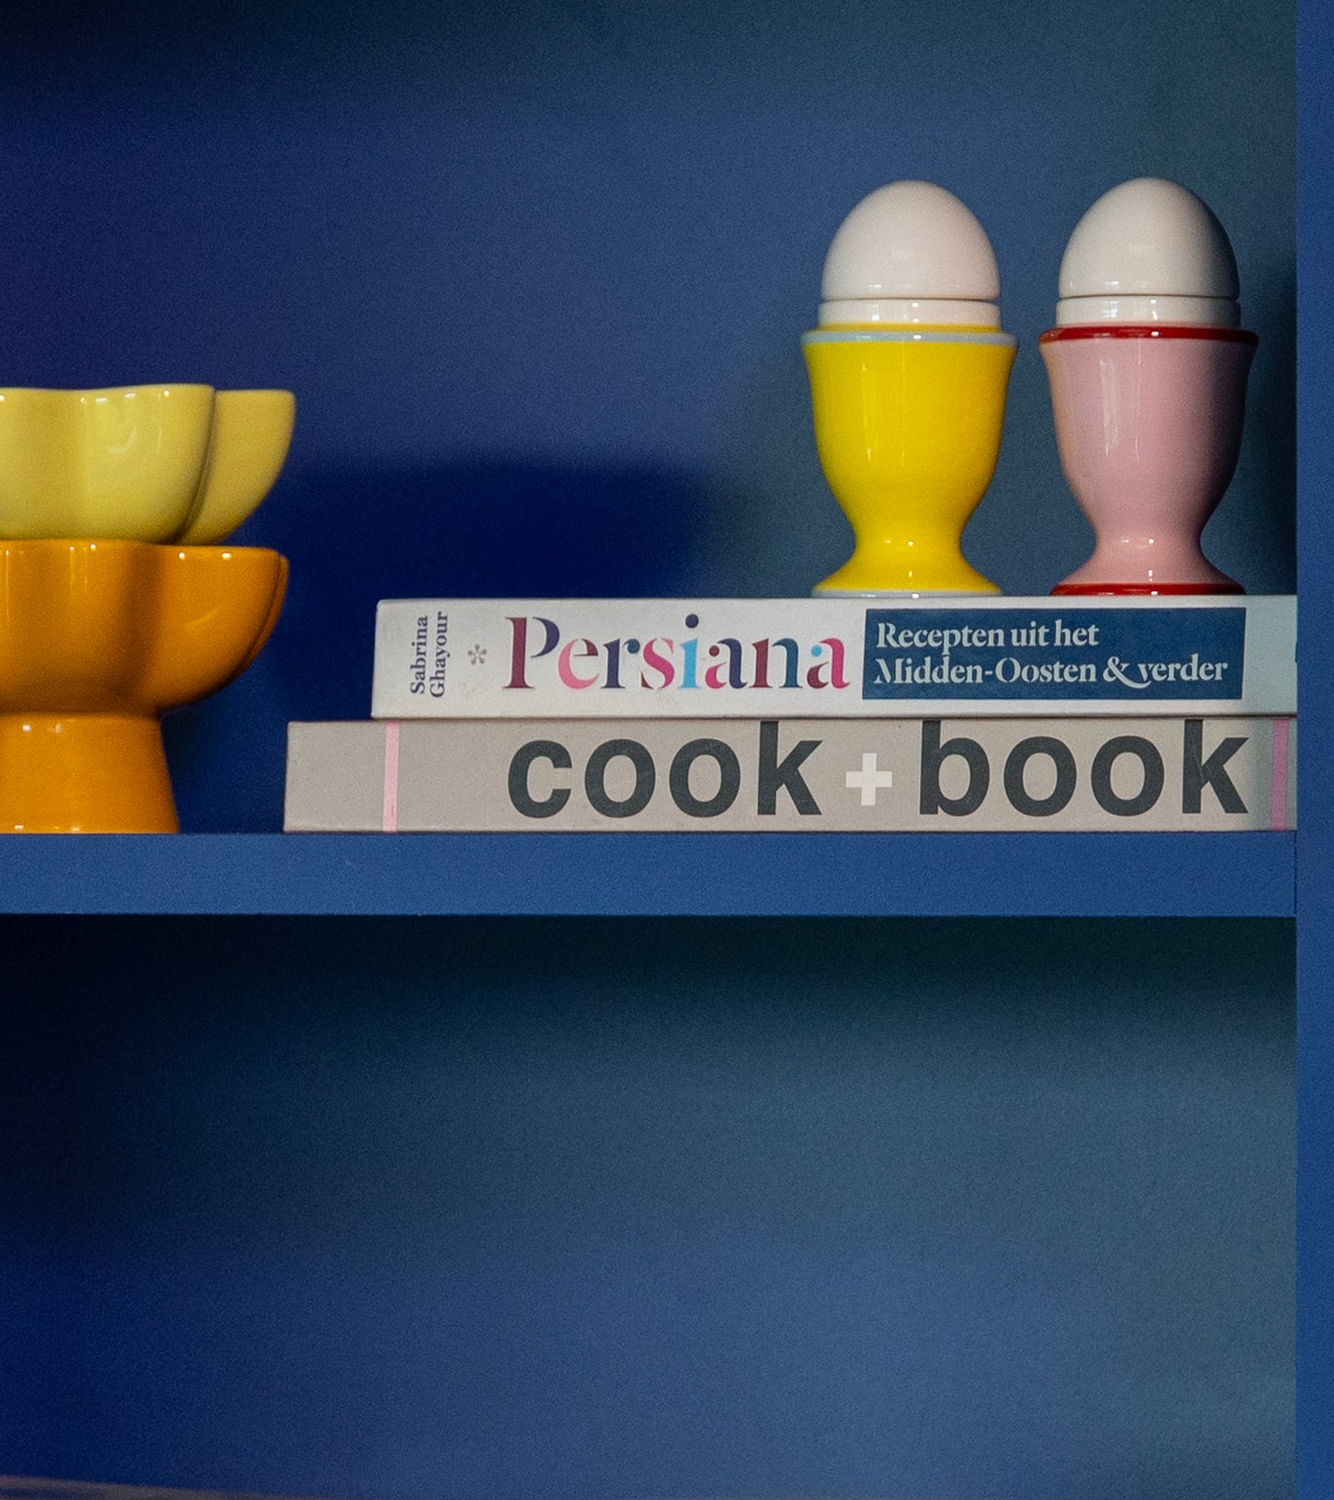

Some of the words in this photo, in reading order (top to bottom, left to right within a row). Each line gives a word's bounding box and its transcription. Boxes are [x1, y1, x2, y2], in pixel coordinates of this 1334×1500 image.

[409, 615, 429, 695] Sabrina
[429, 611, 450, 699] Ghayour
[501, 612, 851, 690] Persiana
[873, 653, 1097, 685] Midden-Oosten
[1103, 655, 1150, 690] &
[1138, 653, 1229, 683] verder
[875, 622, 1010, 655] Recepten
[1011, 621, 1050, 648] uit
[1054, 618, 1099, 647] het
[507, 719, 823, 820] cook
[918, 718, 1250, 818] book
